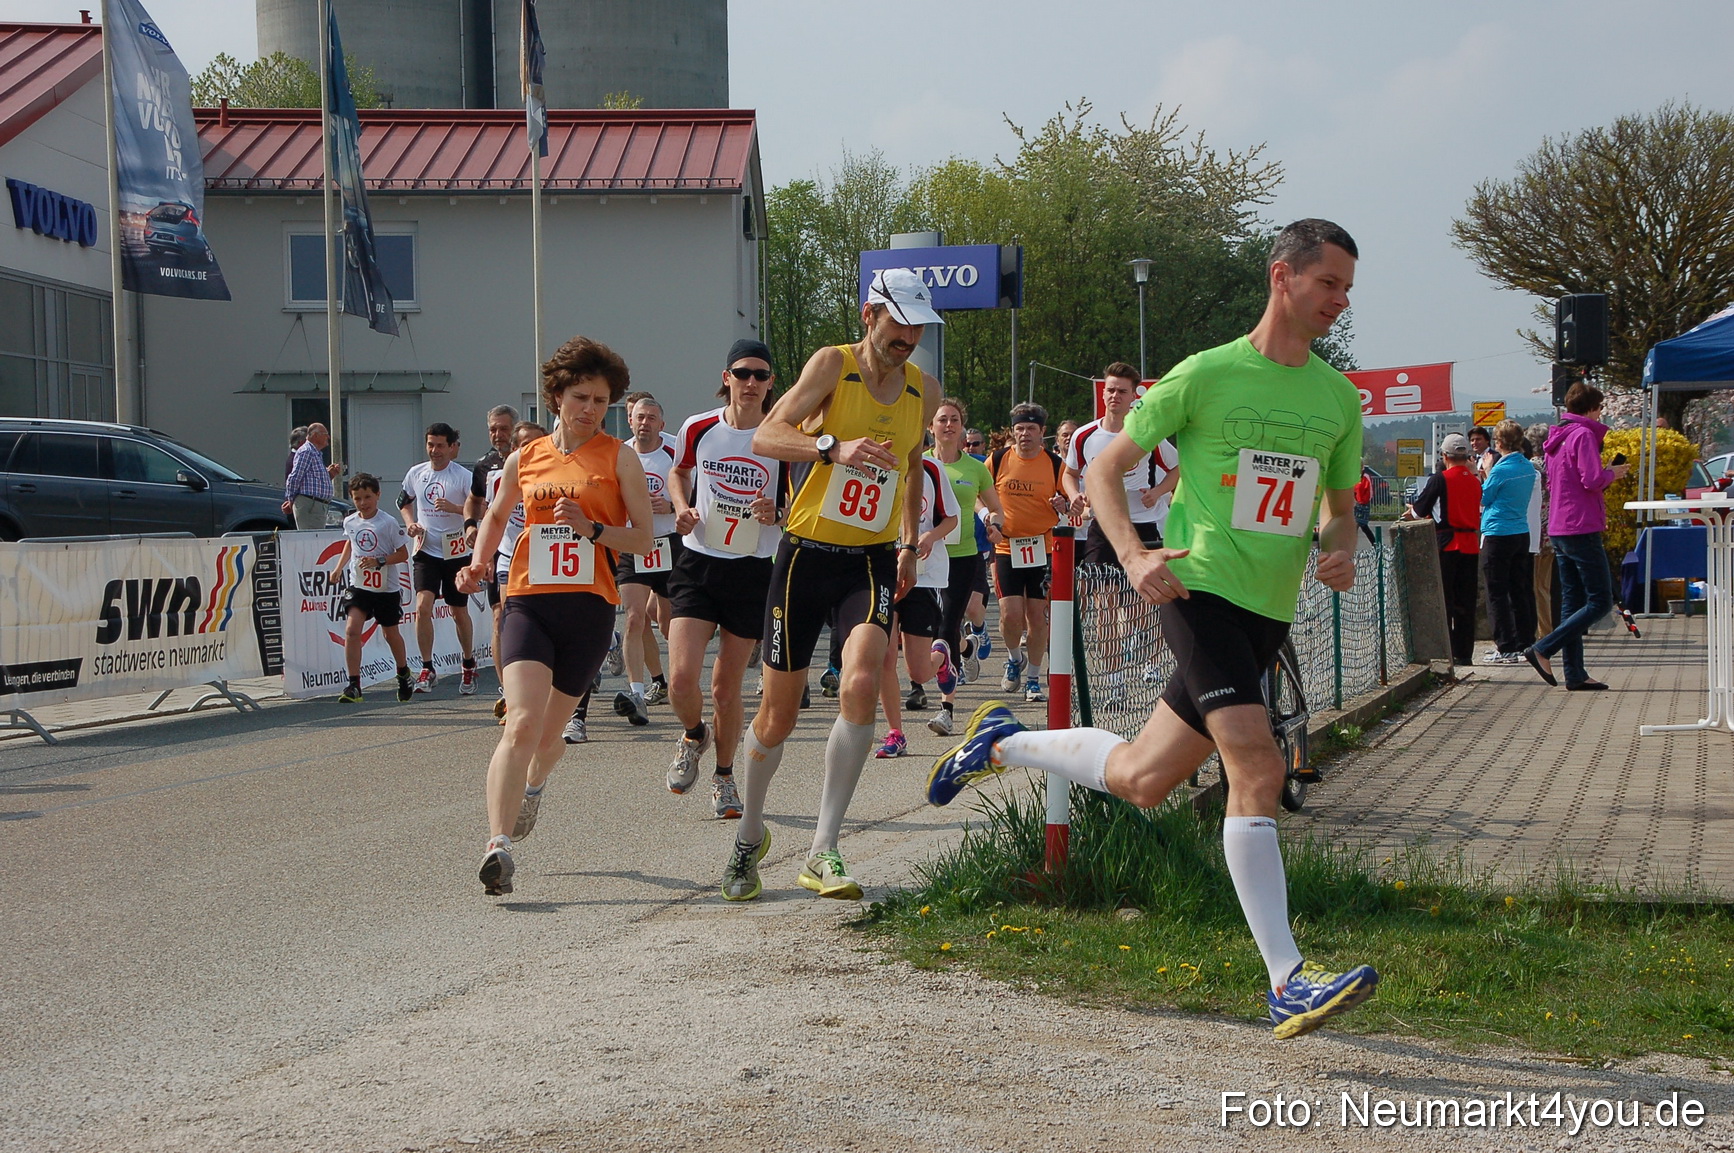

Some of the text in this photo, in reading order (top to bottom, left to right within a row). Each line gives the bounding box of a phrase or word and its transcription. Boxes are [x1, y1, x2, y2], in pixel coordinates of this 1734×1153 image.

[142, 26, 172, 47] VOLV
[5, 177, 97, 248] VOLVO
[160, 267, 207, 280] VOLVOCARS.DE
[872, 265, 979, 288] LVO
[702, 460, 757, 477] GERHART
[1252, 454, 1291, 468] MEYER
[1252, 464, 1290, 475] WERBUNG
[845, 468, 872, 481] WERBUN
[533, 486, 580, 501] OEXL
[1008, 482, 1035, 492] OEXL
[716, 503, 741, 513] MEYER
[839, 479, 882, 522] 93
[1256, 476, 1295, 526] 74
[1067, 515, 1083, 527] 30
[541, 527, 570, 535] MEYER
[724, 517, 739, 546] 7
[450, 537, 466, 556] 23
[1020, 546, 1034, 564] 11
[549, 542, 579, 577] 15
[643, 549, 661, 569] 81
[363, 570, 382, 588] 20
[771, 618, 781, 664] SKINS
[94, 639, 225, 676] stadtwerke neumarkt
